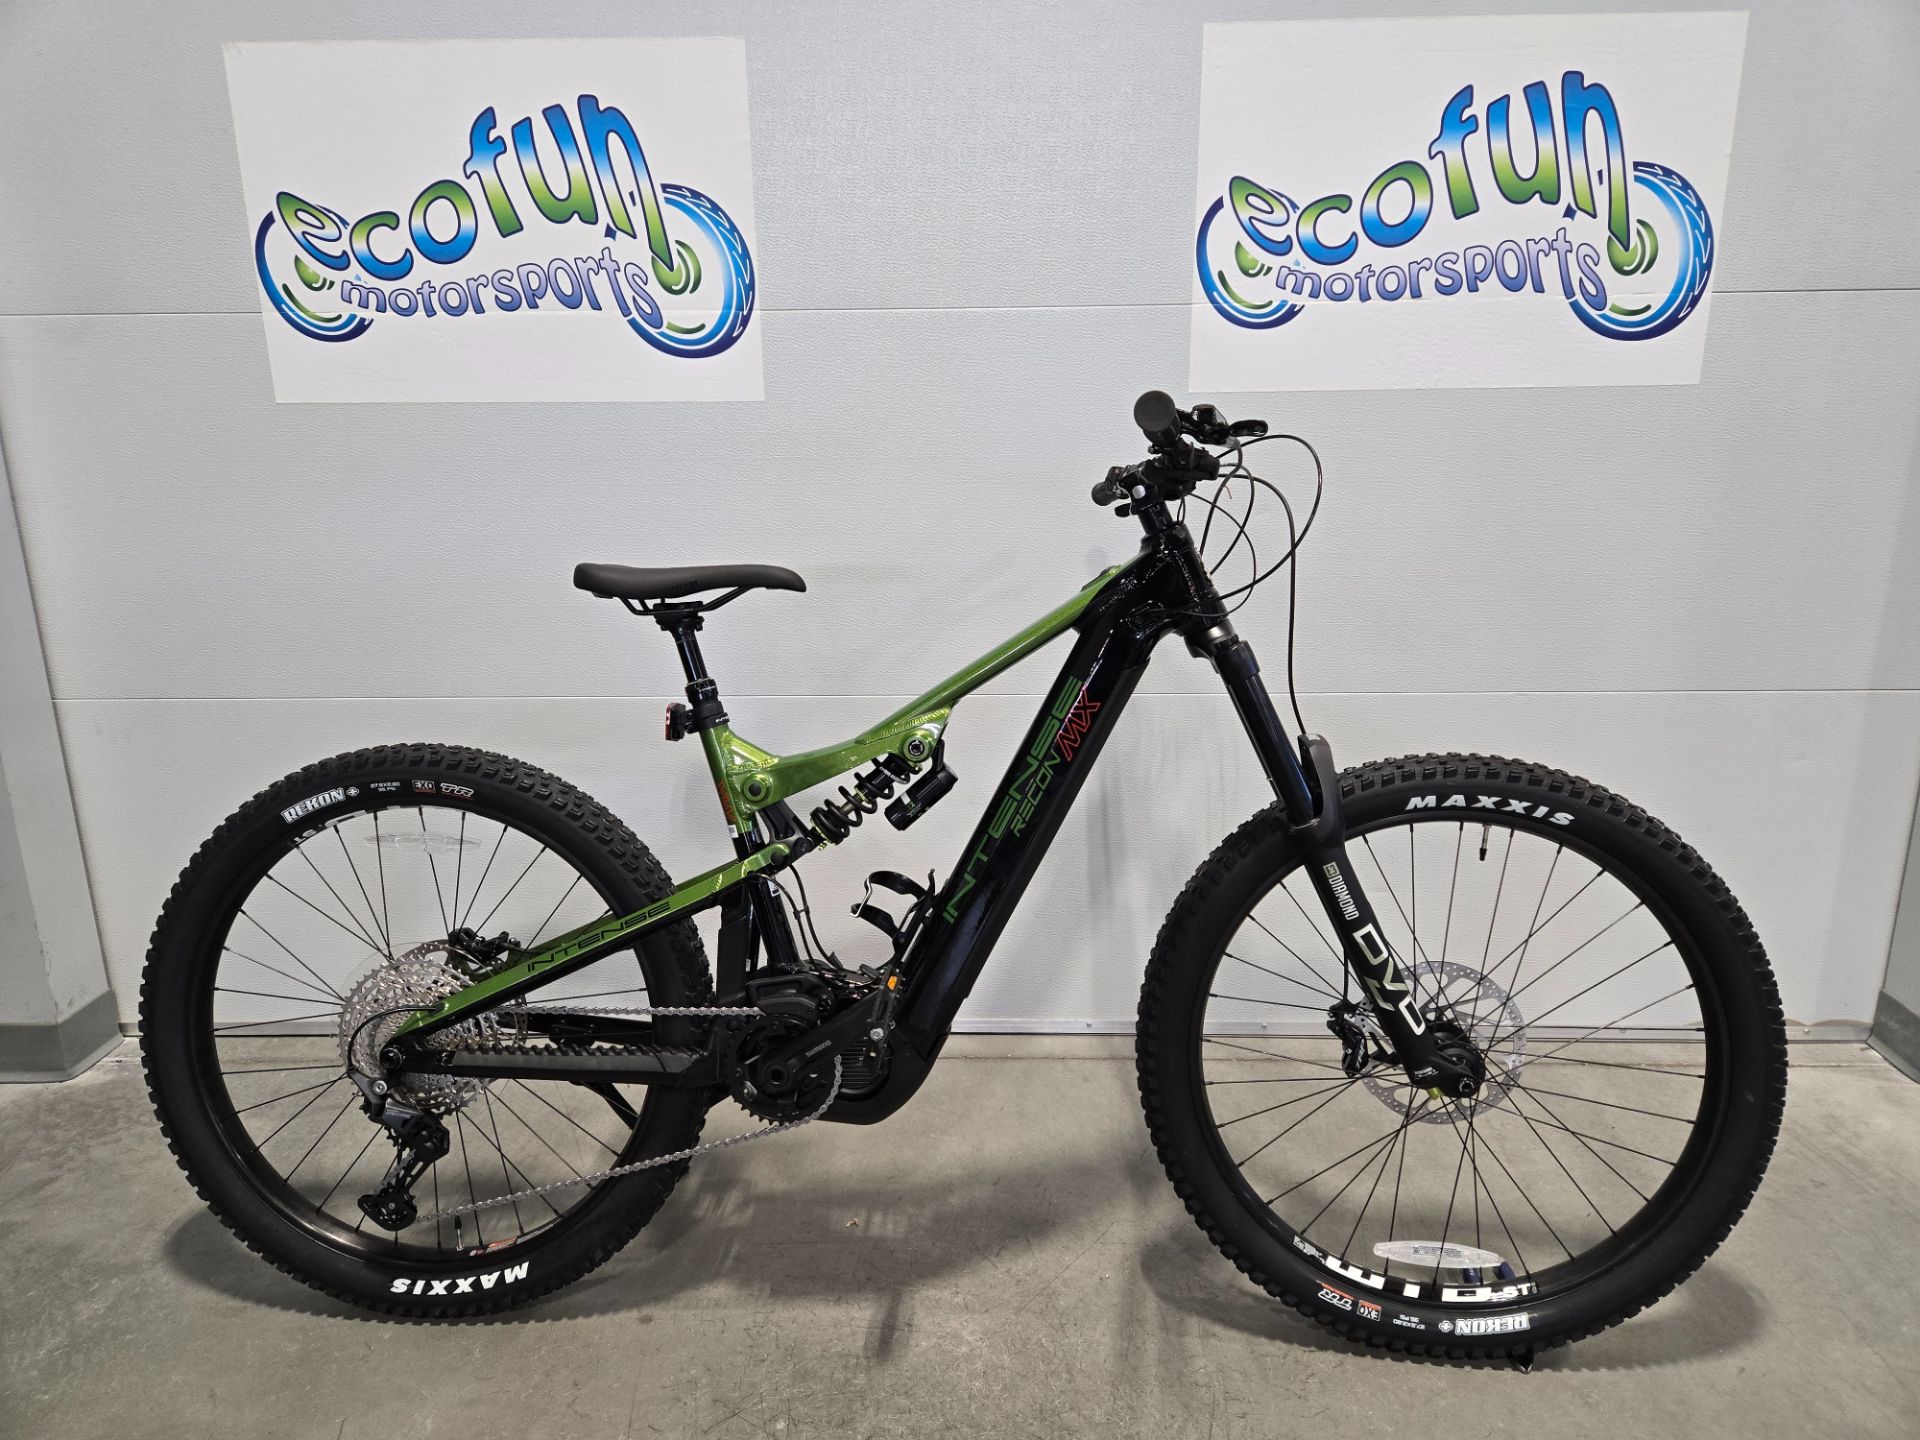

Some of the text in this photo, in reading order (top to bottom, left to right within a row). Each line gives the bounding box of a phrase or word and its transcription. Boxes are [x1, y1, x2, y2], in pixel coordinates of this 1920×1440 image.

[1275, 227, 1607, 311] motorsports
[340, 247, 664, 330] motorsports
[1011, 689, 1101, 837] RECON MX
[281, 788, 346, 824] REKON
[412, 780, 475, 798] EXO TR
[943, 676, 1083, 923] INTENSE
[1405, 794, 1575, 826] MAXXIS
[1328, 875, 1360, 920] DIAMOND
[527, 901, 671, 973] INTENSE
[390, 1261, 530, 1296] MAXXIS
[1317, 1288, 1353, 1311] TR
[1357, 1301, 1381, 1321] EXO
[1455, 1312, 1530, 1336] REKON
